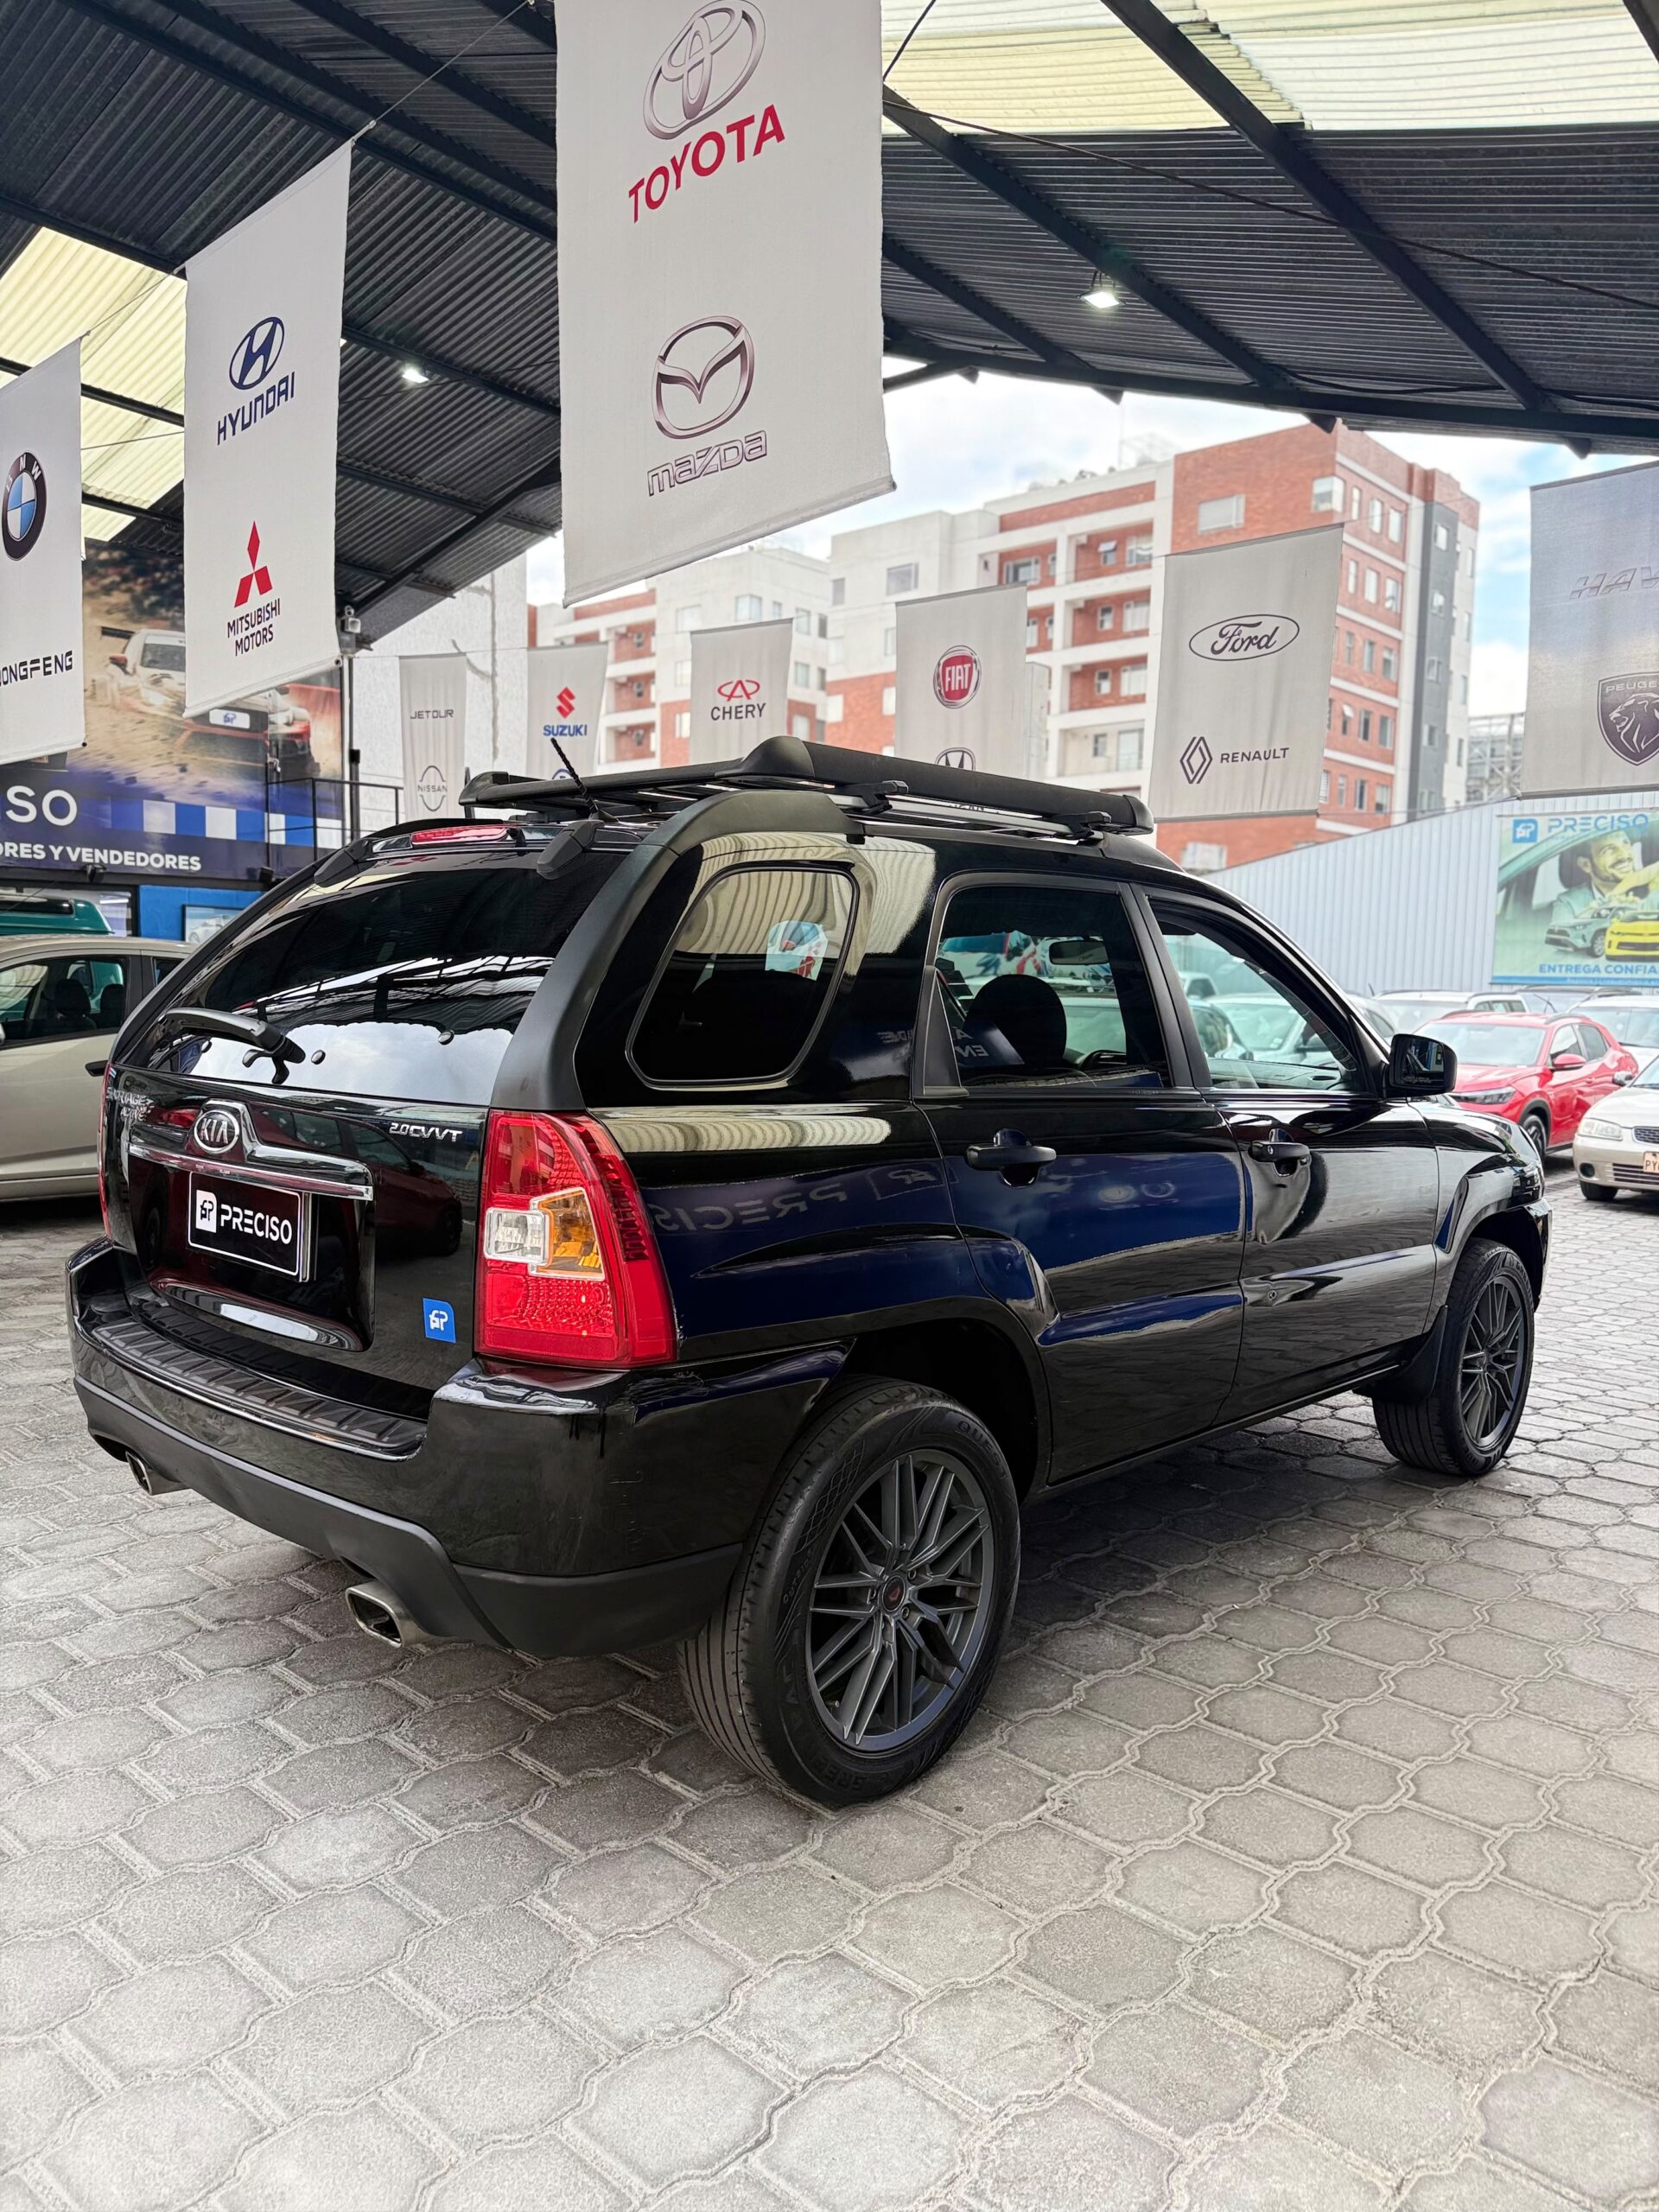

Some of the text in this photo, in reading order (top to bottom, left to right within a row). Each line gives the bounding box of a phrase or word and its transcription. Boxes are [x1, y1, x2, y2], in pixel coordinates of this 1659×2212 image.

[628, 104, 785, 224] TOYOTA
[217, 372, 296, 446] HYUNDAI
[227, 598, 281, 638] MITSUBISHI
[235, 626, 274, 657] MOTORS
[1211, 621, 1280, 655] Ford
[0, 650, 73, 687] ONGFENG
[944, 663, 971, 692] FIAT
[410, 709, 454, 719] JETOUR
[710, 702, 766, 721] CHERY
[543, 724, 587, 737] SUZUKI
[1220, 747, 1290, 764] RENAULT
[1548, 814, 1649, 833] PRECISO
[0, 842, 202, 871] RES Y VENDEDORES
[1539, 963, 1602, 975] ENTREGA
[200, 1118, 228, 1144] KIA
[220, 1204, 292, 1244] PRECISO
